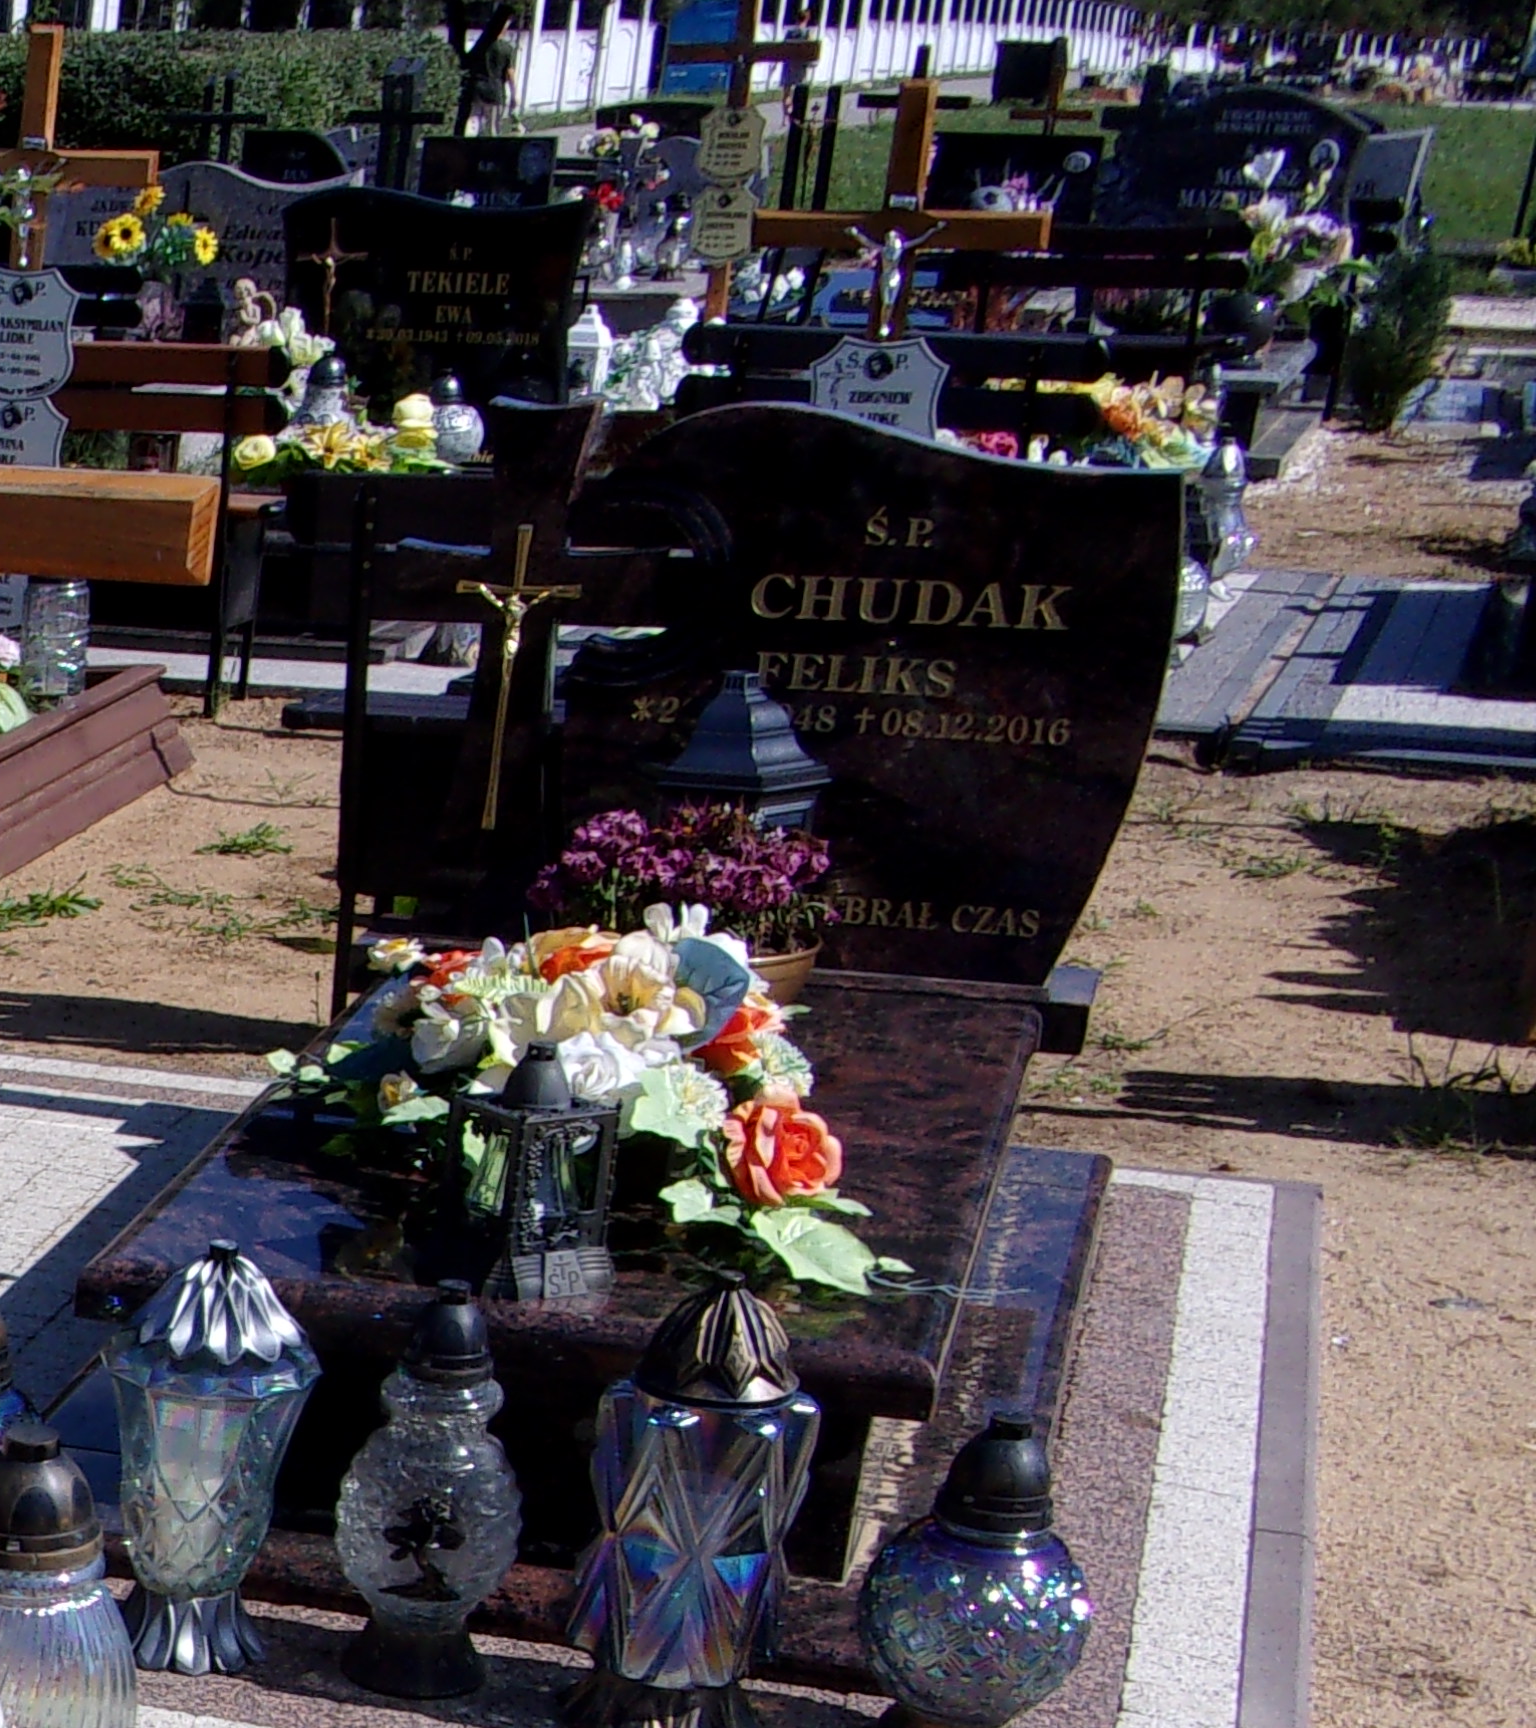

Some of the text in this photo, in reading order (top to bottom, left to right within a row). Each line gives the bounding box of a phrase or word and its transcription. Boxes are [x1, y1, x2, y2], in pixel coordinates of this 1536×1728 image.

[406, 270, 511, 296] TEKIELE
[434, 304, 473, 324] EWA
[0, 332, 34, 345] LIDKE
[895, 353, 909, 370] P.
[848, 390, 913, 405] ZBIGNIEW
[864, 505, 934, 548] Ś. P.
[750, 572, 1074, 631] CHUDAK
[755, 650, 959, 699] FELIKS
[881, 706, 1073, 746] 08.12.2016
[950, 903, 1041, 939] CZAS
